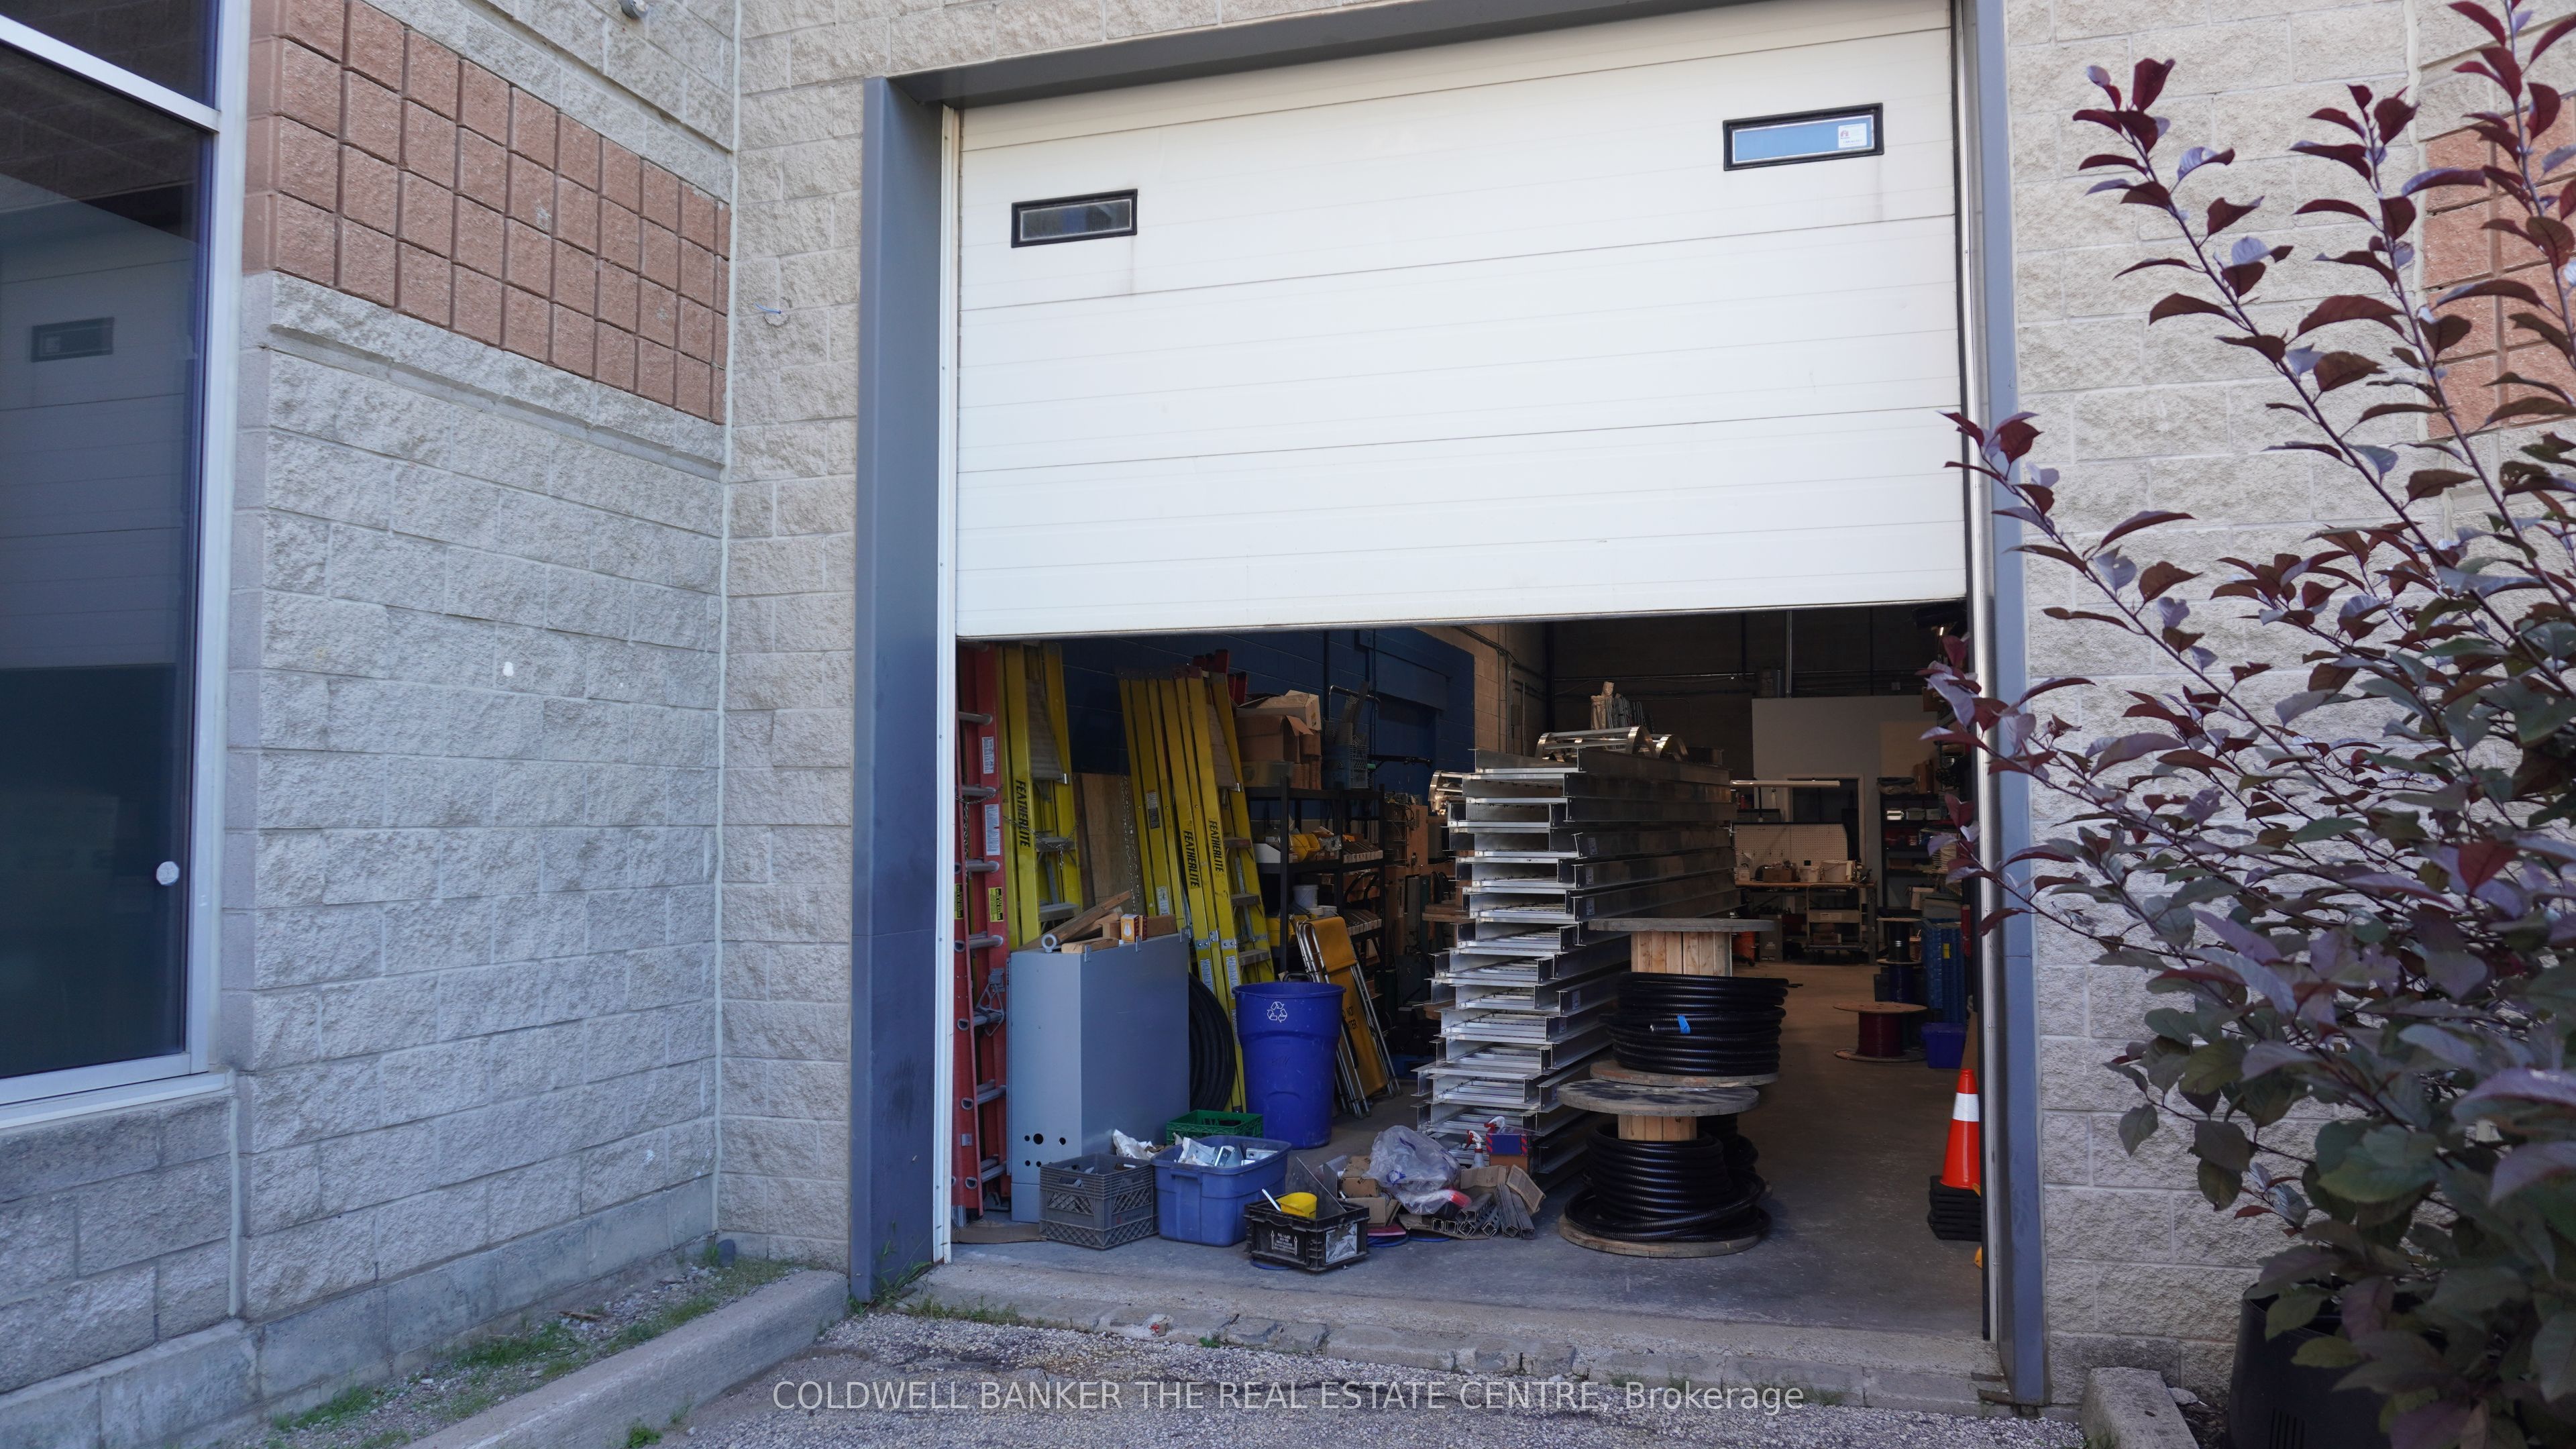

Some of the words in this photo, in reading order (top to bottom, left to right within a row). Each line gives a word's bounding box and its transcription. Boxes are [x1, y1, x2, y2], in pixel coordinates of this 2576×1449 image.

[1016, 780, 1030, 847] FEATHERLITE
[1183, 830, 1200, 888] FEATHERLITE
[1209, 820, 1224, 872] FEATHERLITE
[1348, 1019, 1358, 1030] TER
